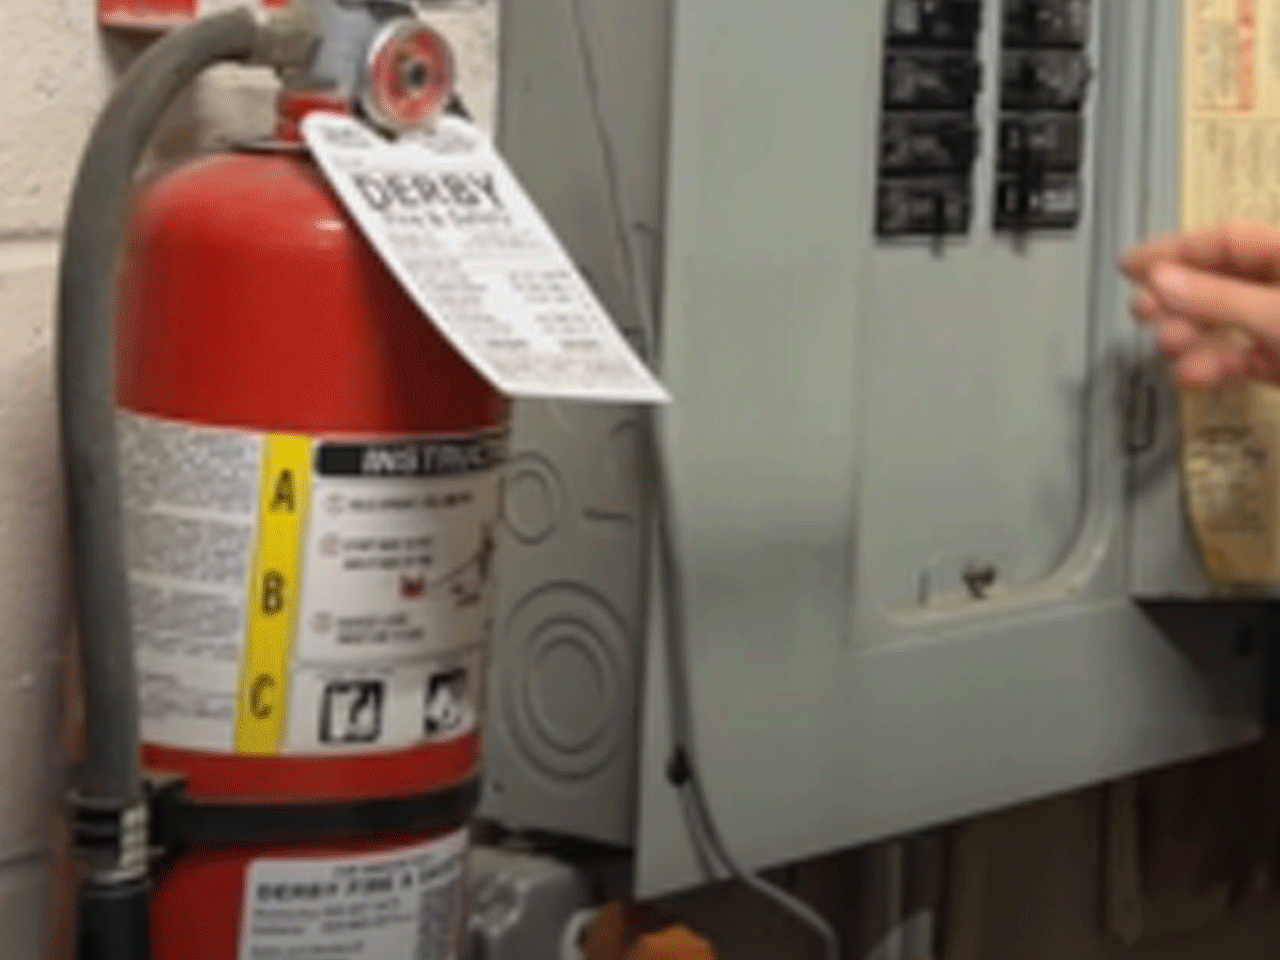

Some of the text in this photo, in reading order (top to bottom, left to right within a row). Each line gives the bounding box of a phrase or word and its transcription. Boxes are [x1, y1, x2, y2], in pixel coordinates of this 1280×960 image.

[351, 172, 505, 211] DERBY
[270, 467, 297, 514] A
[260, 569, 286, 617] B
[250, 672, 276, 721] C
[256, 880, 340, 903] DERBY
